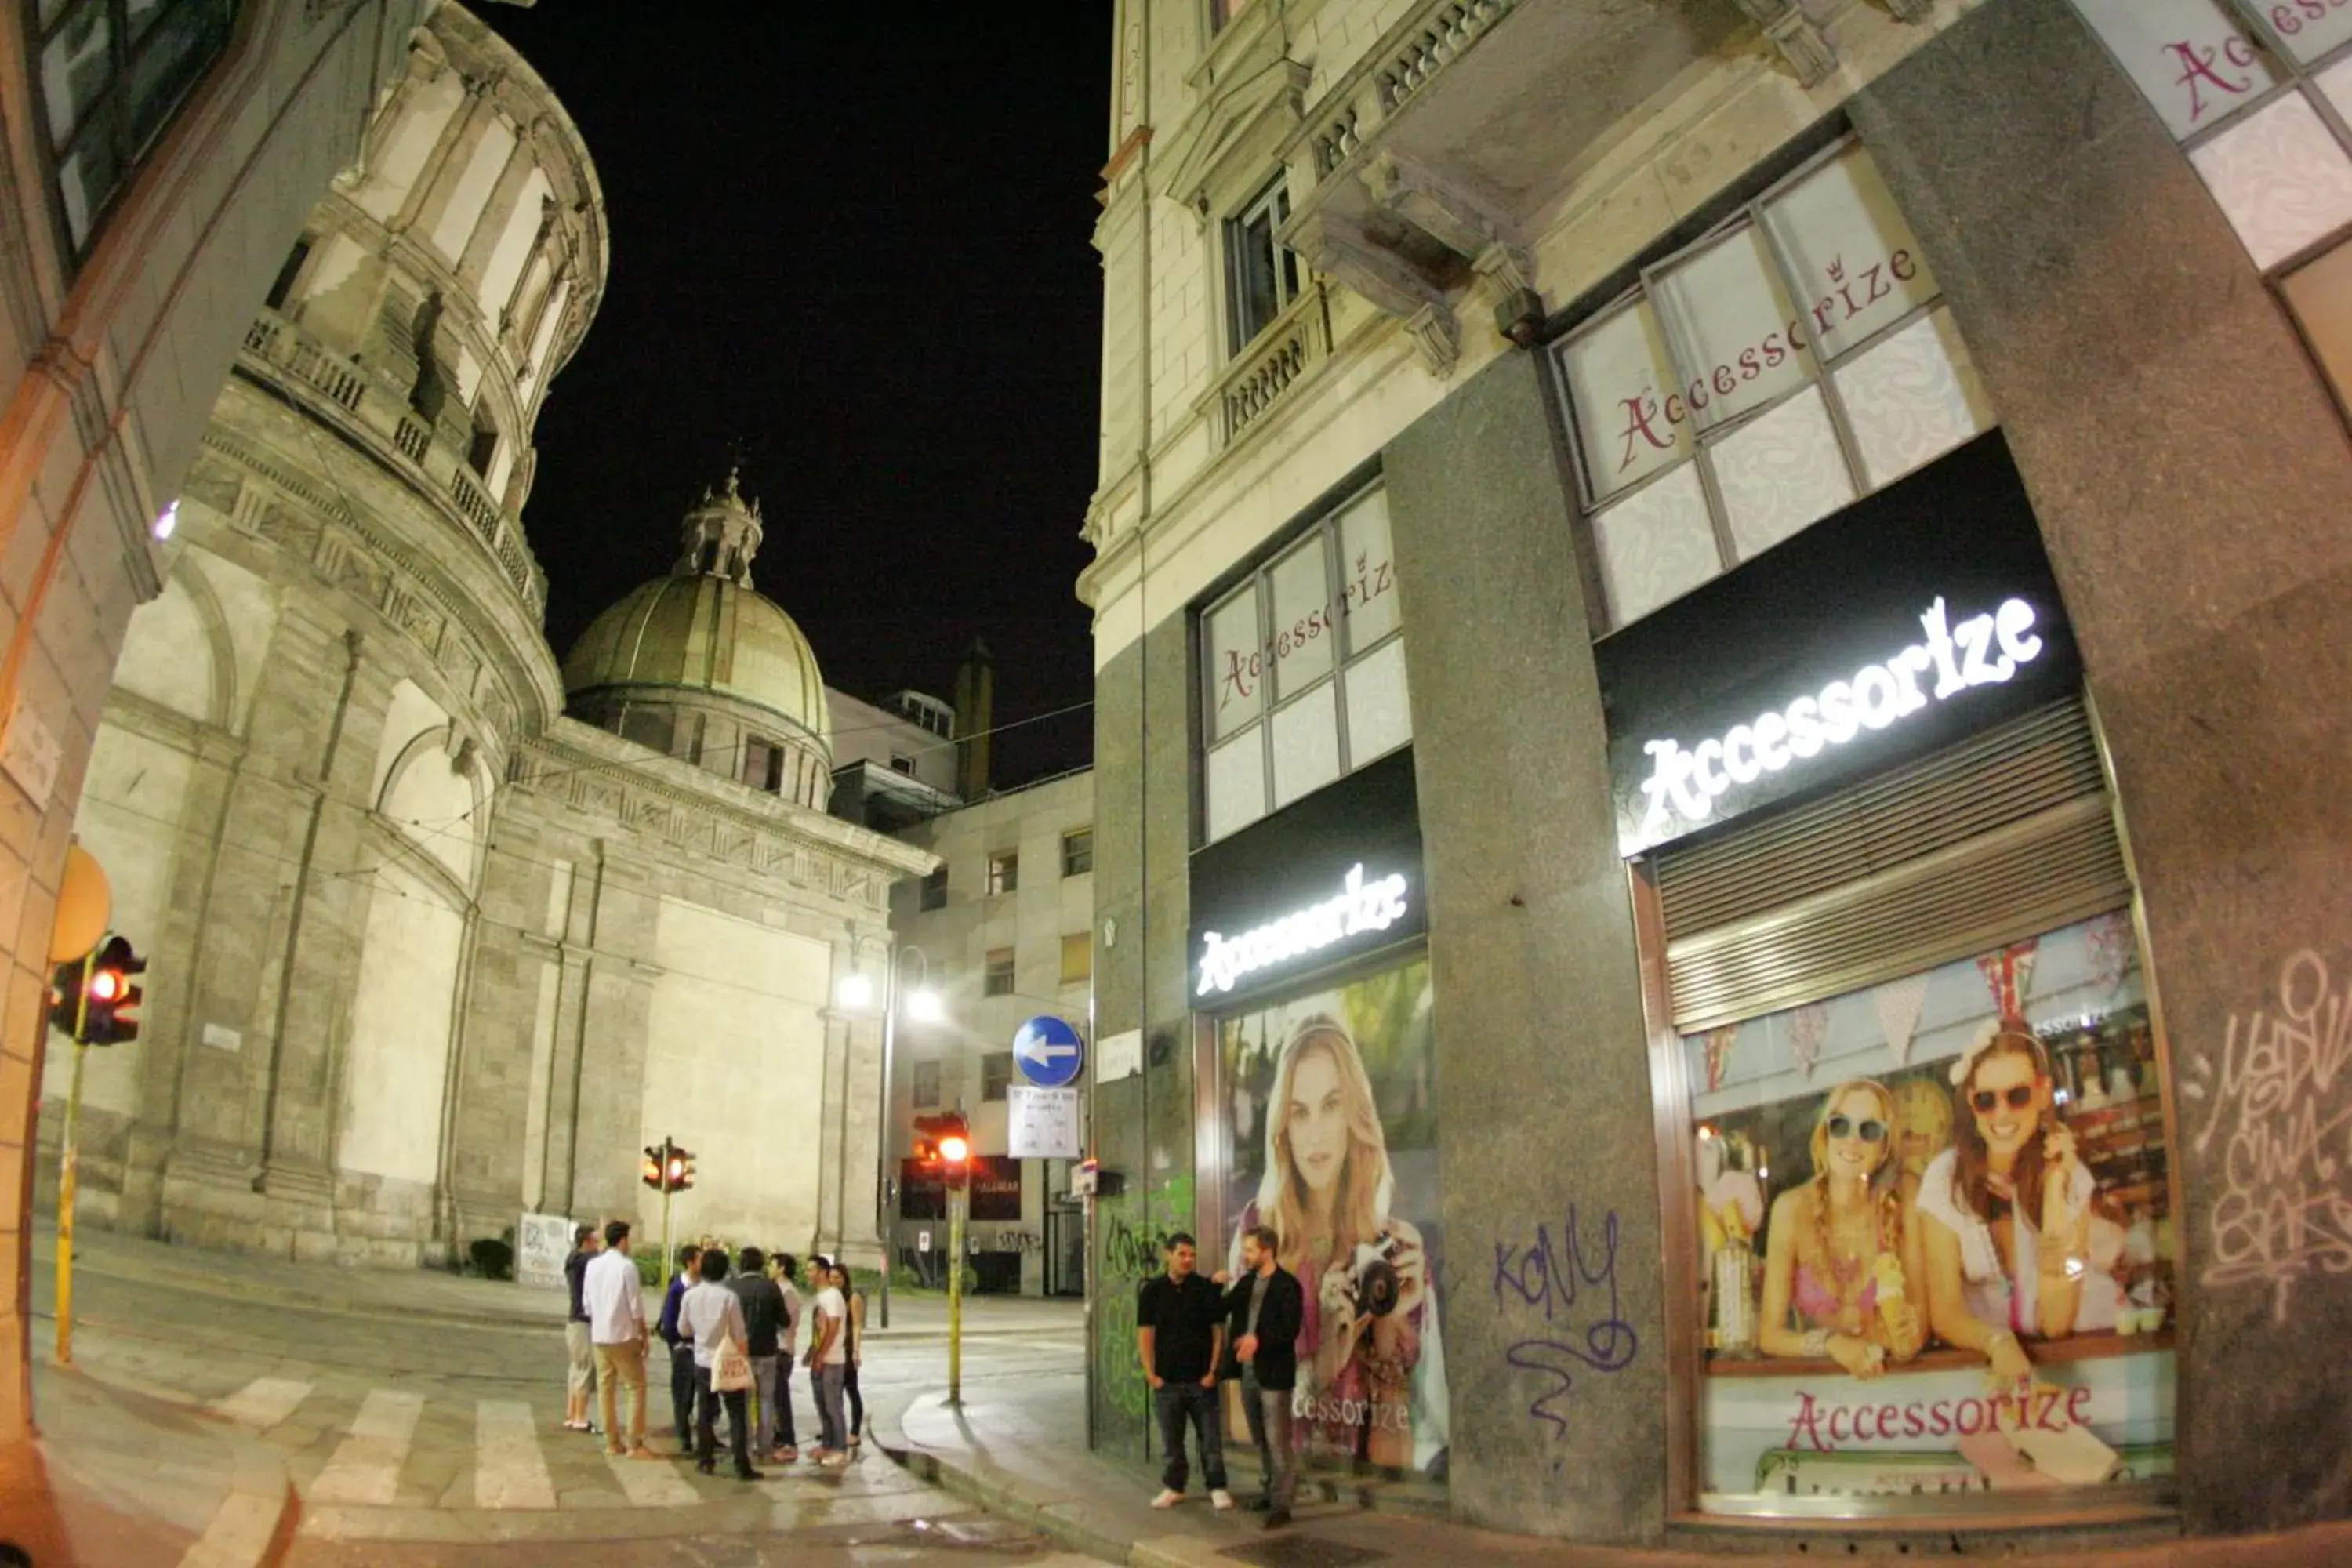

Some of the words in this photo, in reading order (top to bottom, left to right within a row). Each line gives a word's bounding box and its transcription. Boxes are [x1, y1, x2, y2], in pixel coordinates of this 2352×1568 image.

[1220, 550, 1392, 710] Accessoriz
[1640, 596, 2042, 837] Accessorize
[1291, 1385, 1410, 1431] cessorize
[1784, 1372, 2093, 1454] Accessorize
